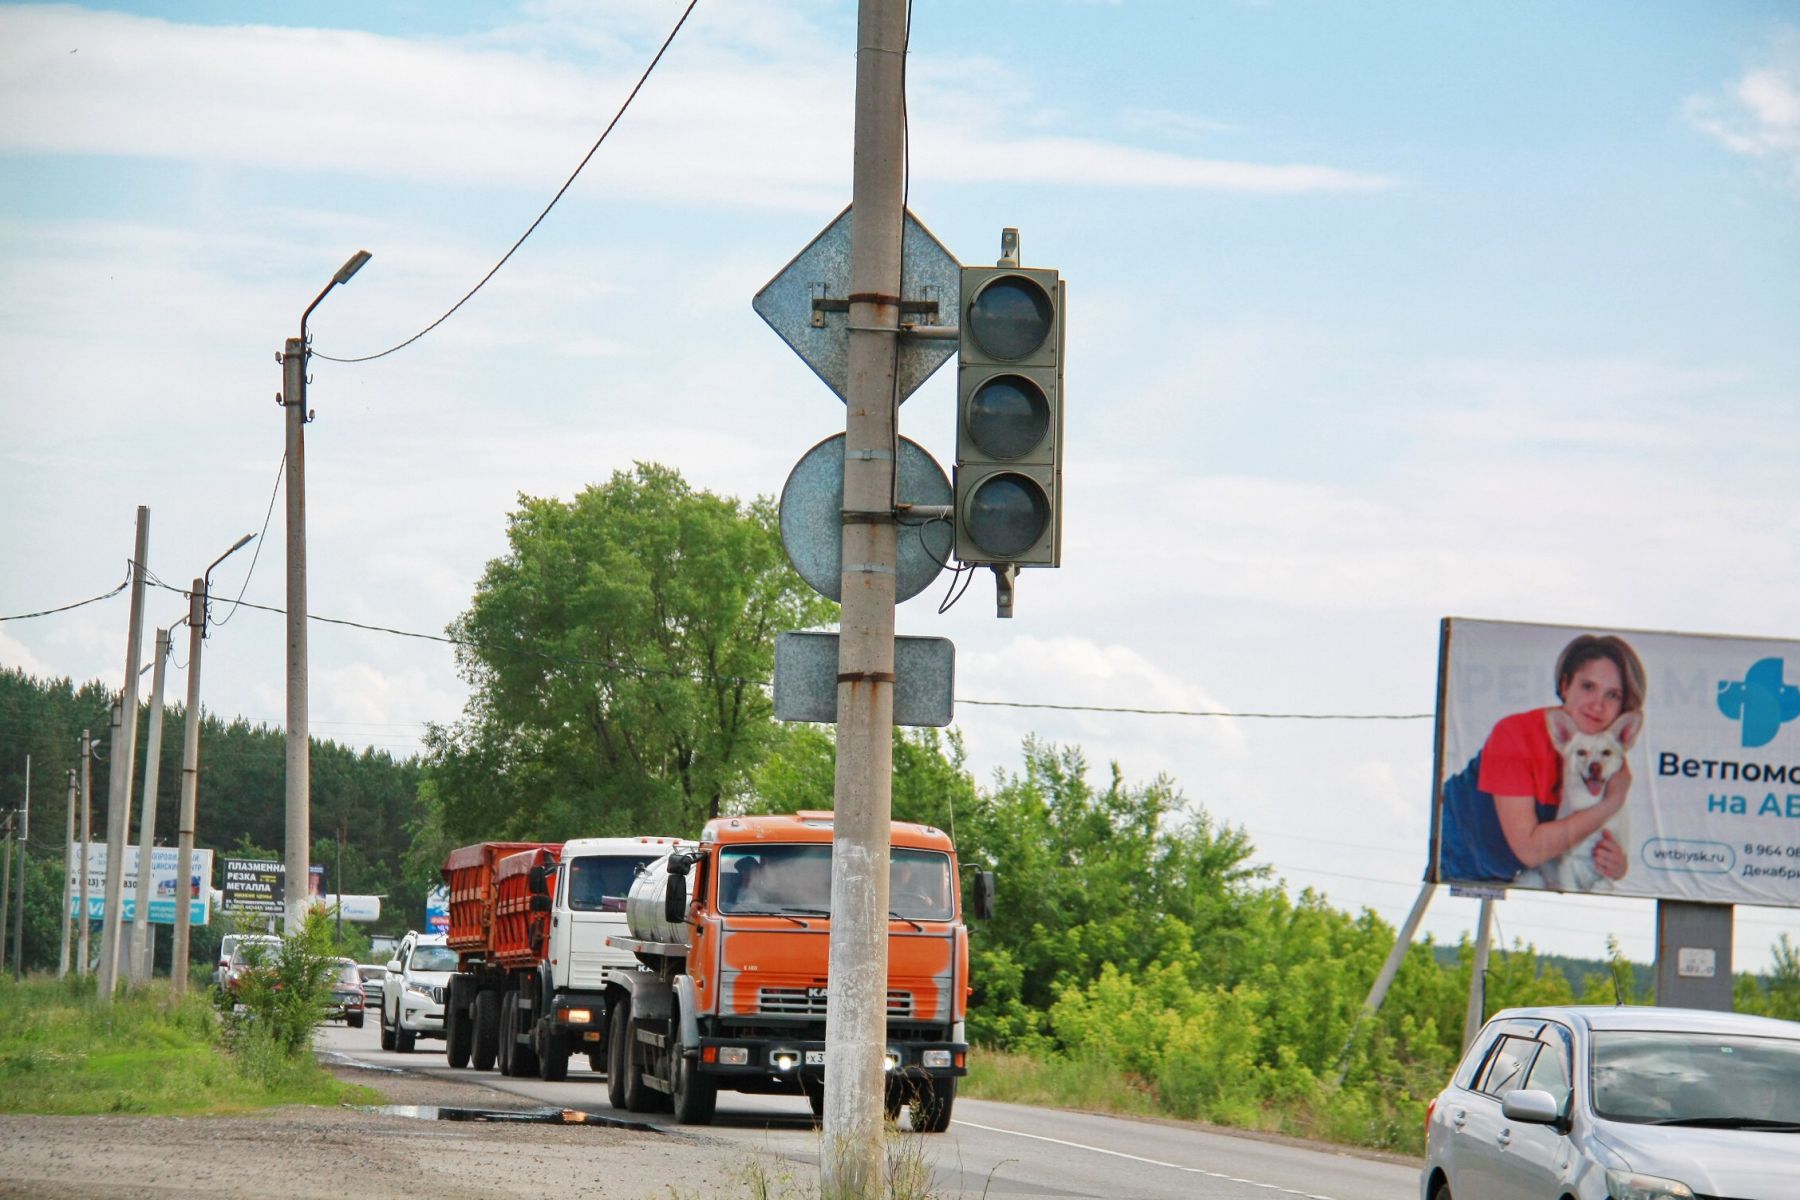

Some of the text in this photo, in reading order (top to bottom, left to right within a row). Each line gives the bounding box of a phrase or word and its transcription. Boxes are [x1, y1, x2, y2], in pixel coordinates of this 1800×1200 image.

[1708, 794, 1747, 815] на
[1744, 843, 1753, 855] 8
[1756, 845, 1782, 857] 964
[1653, 850, 1725, 863] vetbiysk.ru
[228, 861, 286, 872] ПЛАЗМЕННА
[227, 872, 256, 881] РЕЗКА
[226, 882, 271, 891] МЕТАЛЛА
